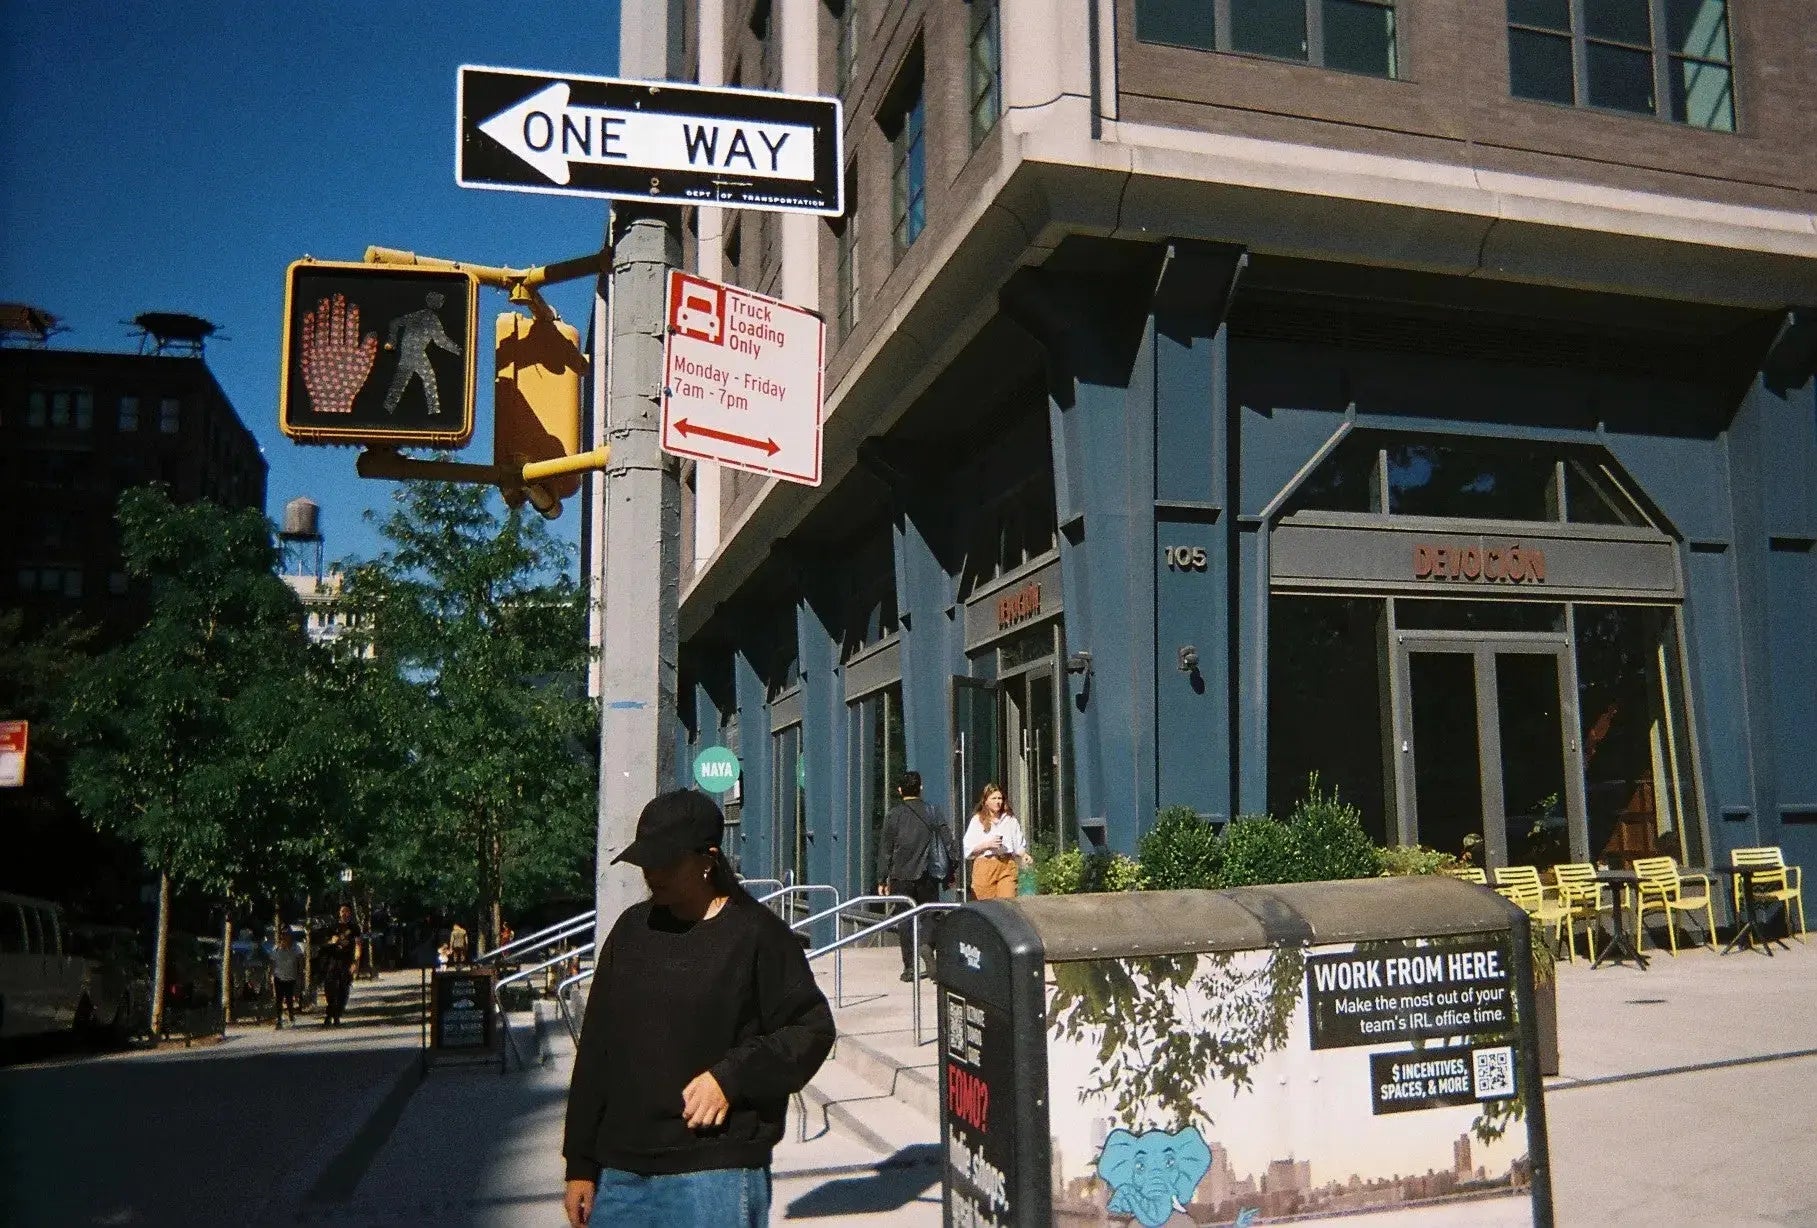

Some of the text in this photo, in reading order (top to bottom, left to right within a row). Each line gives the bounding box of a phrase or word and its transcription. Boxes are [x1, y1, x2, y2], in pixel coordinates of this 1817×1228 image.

[522, 110, 790, 172] ONE WAY
[686, 190, 711, 198] DEPT
[742, 194, 825, 207] TRANSPORTATION
[731, 297, 772, 323] Truck
[730, 315, 785, 348] Loading
[729, 334, 761, 360] Only
[674, 355, 730, 387] Monday
[744, 373, 786, 401] Friday
[674, 377, 704, 399] 7am
[719, 389, 748, 411] 7pm
[1165, 546, 1207, 568] 105
[1415, 545, 1545, 581] DEVOCIÓN
[701, 762, 733, 777] NAYA
[1314, 950, 1505, 992] WORK FROM HERE.
[1336, 987, 1505, 1015] Make the most out of your
[1360, 1008, 1505, 1034] team's IRL office time.
[1392, 1058, 1468, 1083] $ INCENTIVES,
[947, 1063, 990, 1134] FOMO?
[1380, 1075, 1469, 1100] SPACES, & MORE
